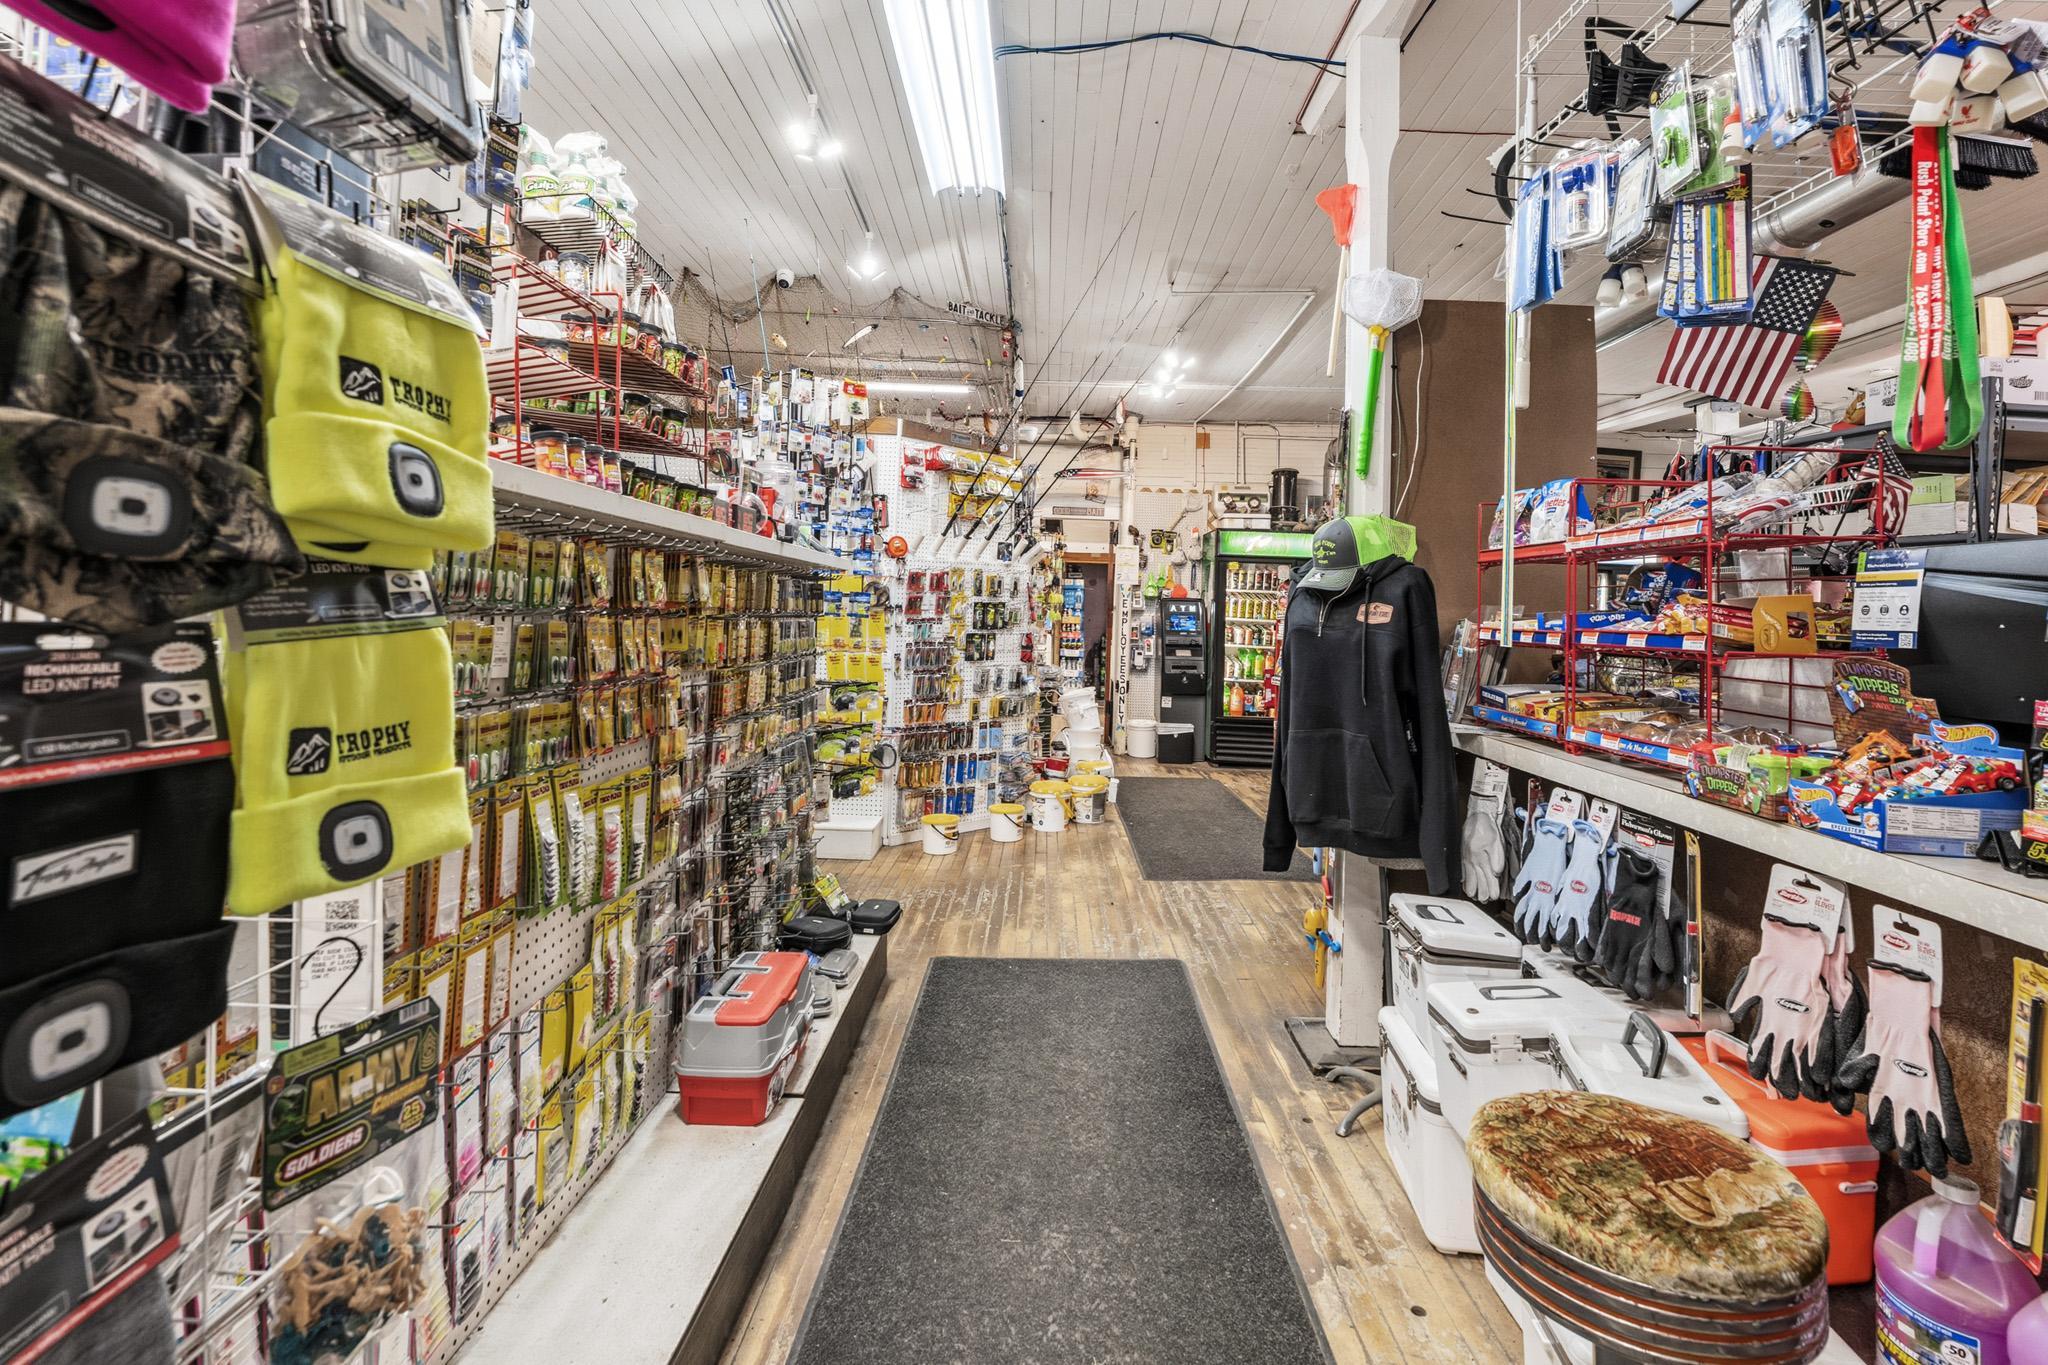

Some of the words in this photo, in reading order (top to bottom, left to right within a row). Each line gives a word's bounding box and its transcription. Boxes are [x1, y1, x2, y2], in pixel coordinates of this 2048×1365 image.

[1916, 161, 1934, 186] Rush
[1916, 189, 1933, 216] Point
[1916, 219, 1933, 247] Store
[1915, 250, 1928, 274] .com
[948, 301, 967, 316] BAIT
[975, 308, 1006, 326] TACKLE
[388, 375, 452, 418] TROPHY
[1170, 604, 1197, 612] ATM
[1119, 598, 1129, 683] EMPLOYEES
[1839, 661, 1906, 684] DUMPSTER
[22, 678, 55, 695] LED
[56, 676, 90, 693] KNIT
[92, 675, 123, 690] HAT
[1850, 675, 1900, 697] DIPPERS
[1118, 685, 1128, 724] ONLY
[336, 720, 411, 754] TROPHY
[1701, 764, 1746, 786] DUMPSTER
[1705, 776, 1739, 795] DIPPERS
[1621, 819, 1653, 835] Fisherman's
[306, 1034, 420, 1129] ARMY
[403, 1100, 421, 1121] 25
[283, 1126, 365, 1181] SOLDIERS
[1949, 1345, 1967, 1359] 50
